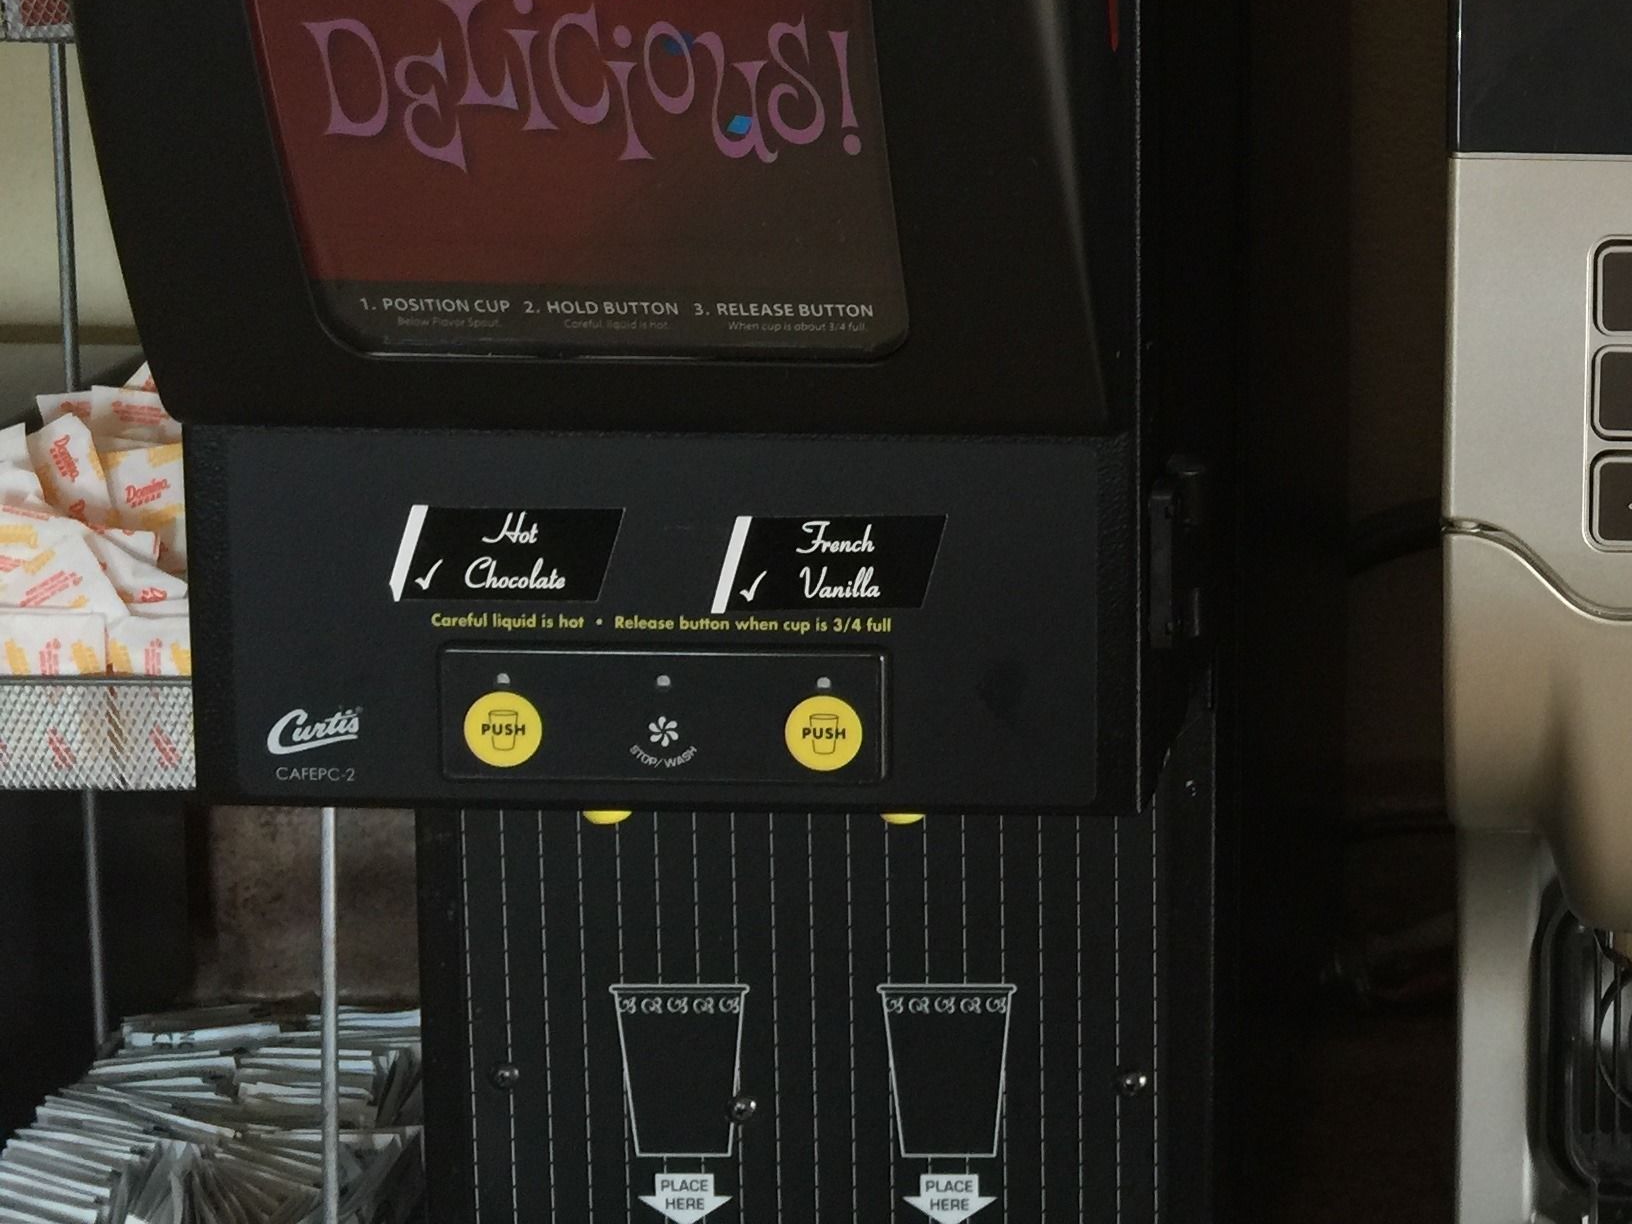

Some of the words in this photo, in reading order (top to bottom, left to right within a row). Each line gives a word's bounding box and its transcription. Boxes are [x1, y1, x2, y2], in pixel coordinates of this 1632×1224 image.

[360, 297, 377, 311] 1.
[382, 297, 470, 313] POSITION
[474, 299, 510, 313] CUP
[523, 300, 540, 314] 2.
[547, 300, 598, 315] HOLD
[604, 302, 679, 316] BUTTON
[694, 302, 711, 316] 3.
[717, 302, 794, 317] RELEASE
[798, 303, 874, 318] BUTTON
[728, 321, 760, 331] When
[761, 322, 782, 332] cup
[794, 321, 826, 332] about
[481, 510, 539, 544] Hot
[796, 520, 875, 554] French
[464, 555, 567, 590] Chocolate
[799, 565, 881, 599] Vanilla
[431, 612, 488, 628] Careful
[492, 613, 537, 631] liquid
[541, 614, 554, 628] is
[558, 614, 585, 629] hot
[614, 615, 675, 631] Release
[680, 615, 731, 631] button
[735, 617, 779, 632] when
[783, 619, 811, 635] cup
[816, 617, 828, 632] is
[833, 616, 862, 633] 3/4
[866, 617, 892, 633] full
[266, 707, 360, 755] Curtis
[481, 723, 526, 736] PUSH
[802, 727, 846, 740] PUSH
[276, 766, 355, 782] CAFEPC-2
[660, 1179, 709, 1193] PLACE
[925, 1180, 974, 1193] PLACE
[664, 1198, 706, 1211] HERE
[929, 1198, 970, 1212] HERE
